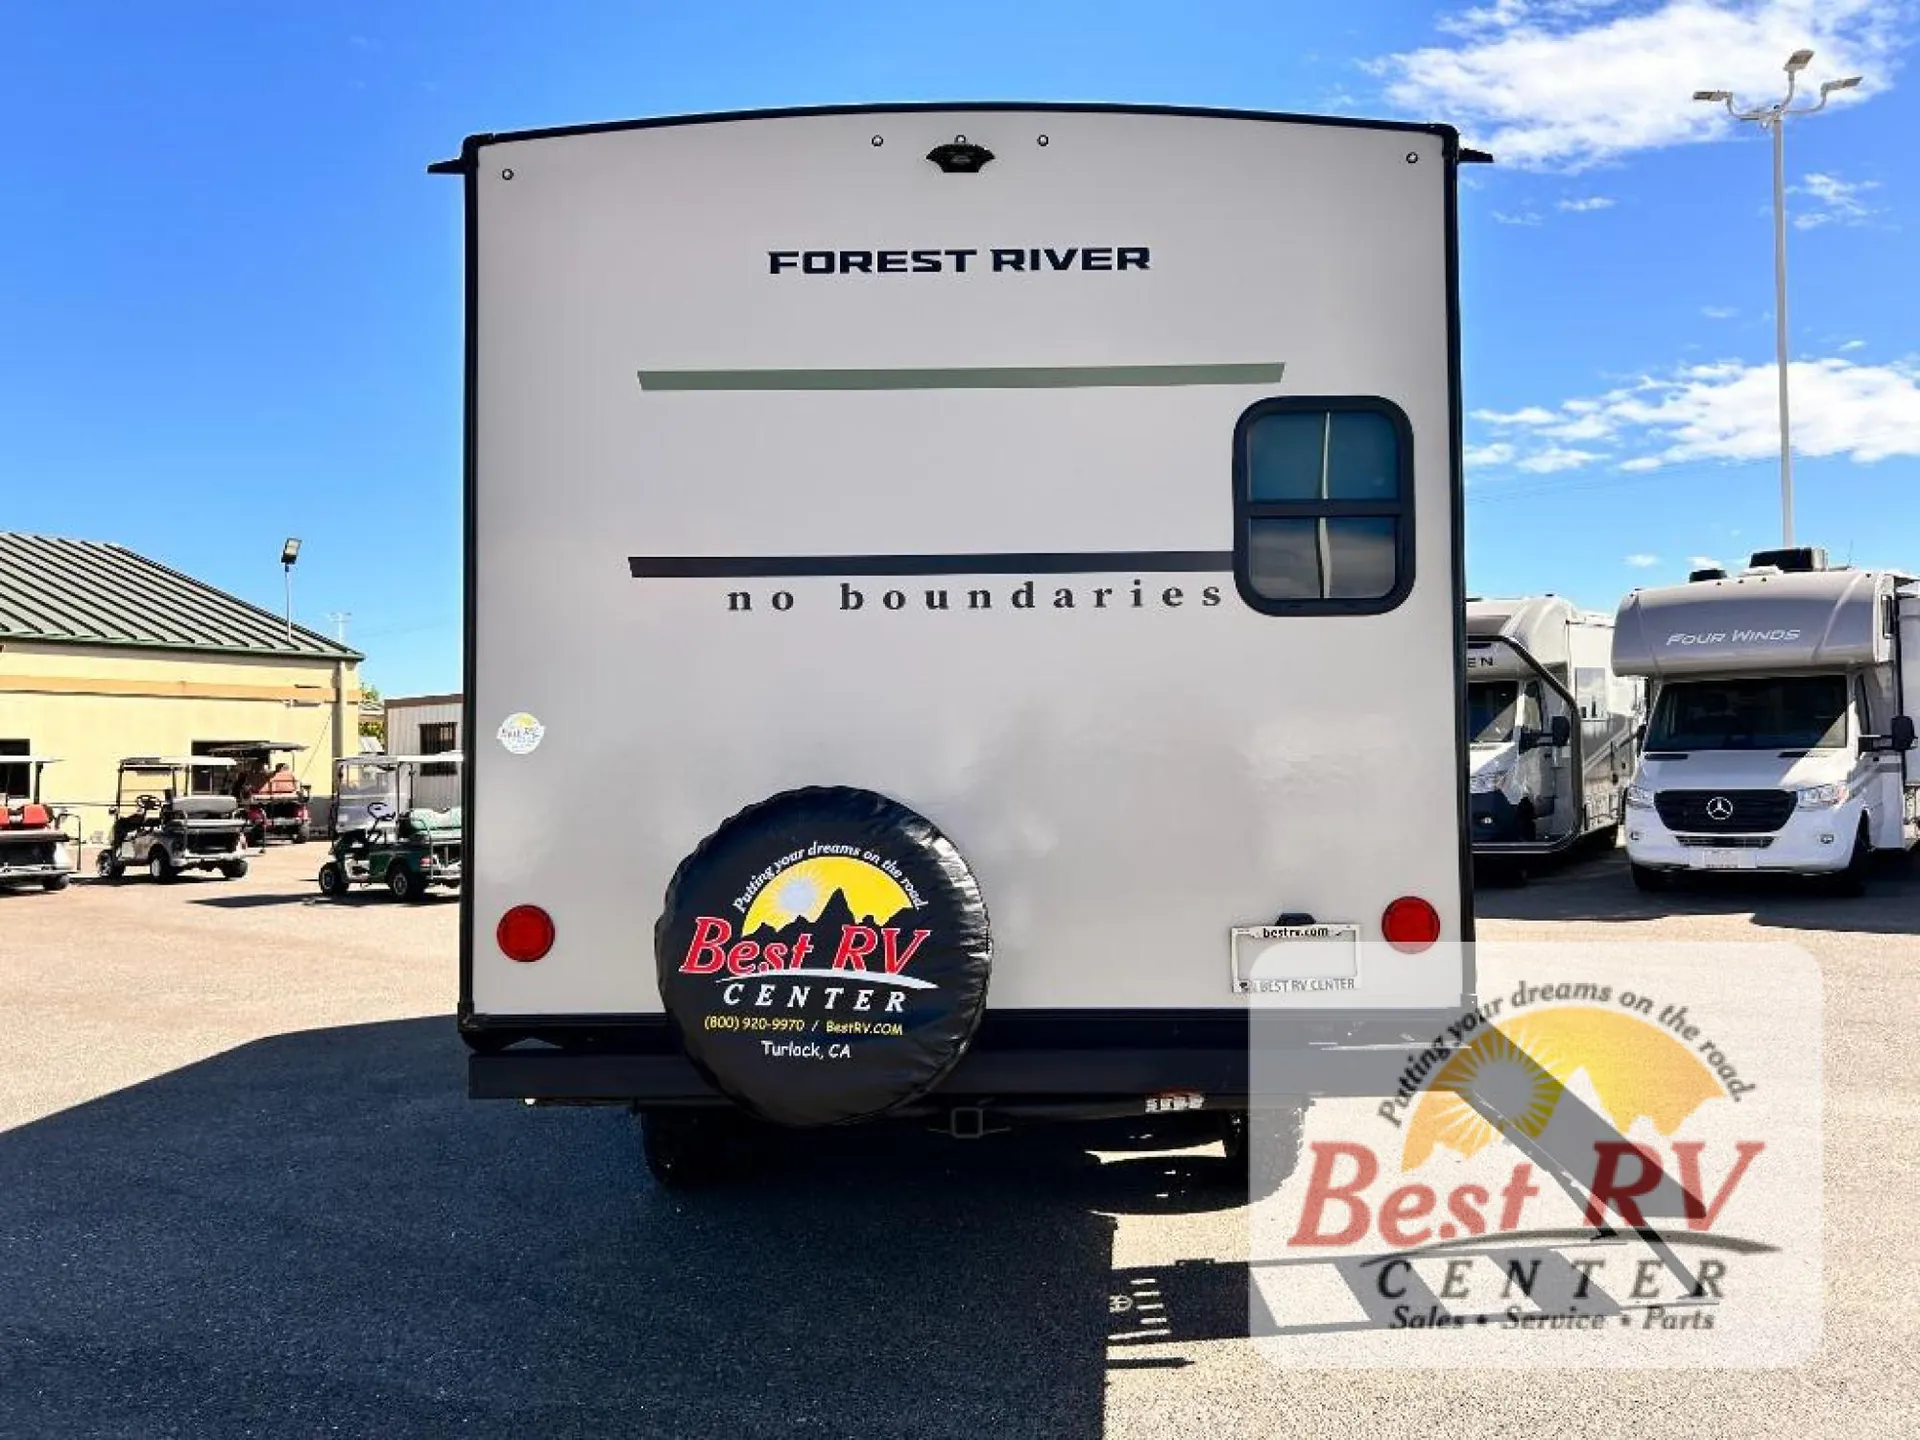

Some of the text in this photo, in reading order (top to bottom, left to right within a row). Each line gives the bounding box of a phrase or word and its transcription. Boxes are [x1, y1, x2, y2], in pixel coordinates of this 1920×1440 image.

[768, 247, 1151, 275] FOREST RIVER
[727, 579, 1222, 612] no boundaries
[1666, 629, 1801, 646] FOUR WINDS
[732, 864, 775, 913] Putting
[774, 848, 805, 873] your
[807, 840, 860, 856] dreams
[863, 850, 881, 864] on
[881, 859, 902, 878] the
[1263, 927, 1329, 938] bestrv.com
[678, 916, 931, 977] Best RV
[1260, 978, 1355, 993] BEST RV CENTER
[723, 983, 906, 1013] CENTER
[704, 1015, 740, 1031] (800)
[742, 1017, 805, 1032] 920-9970
[761, 1040, 852, 1059] Turlock, CA
